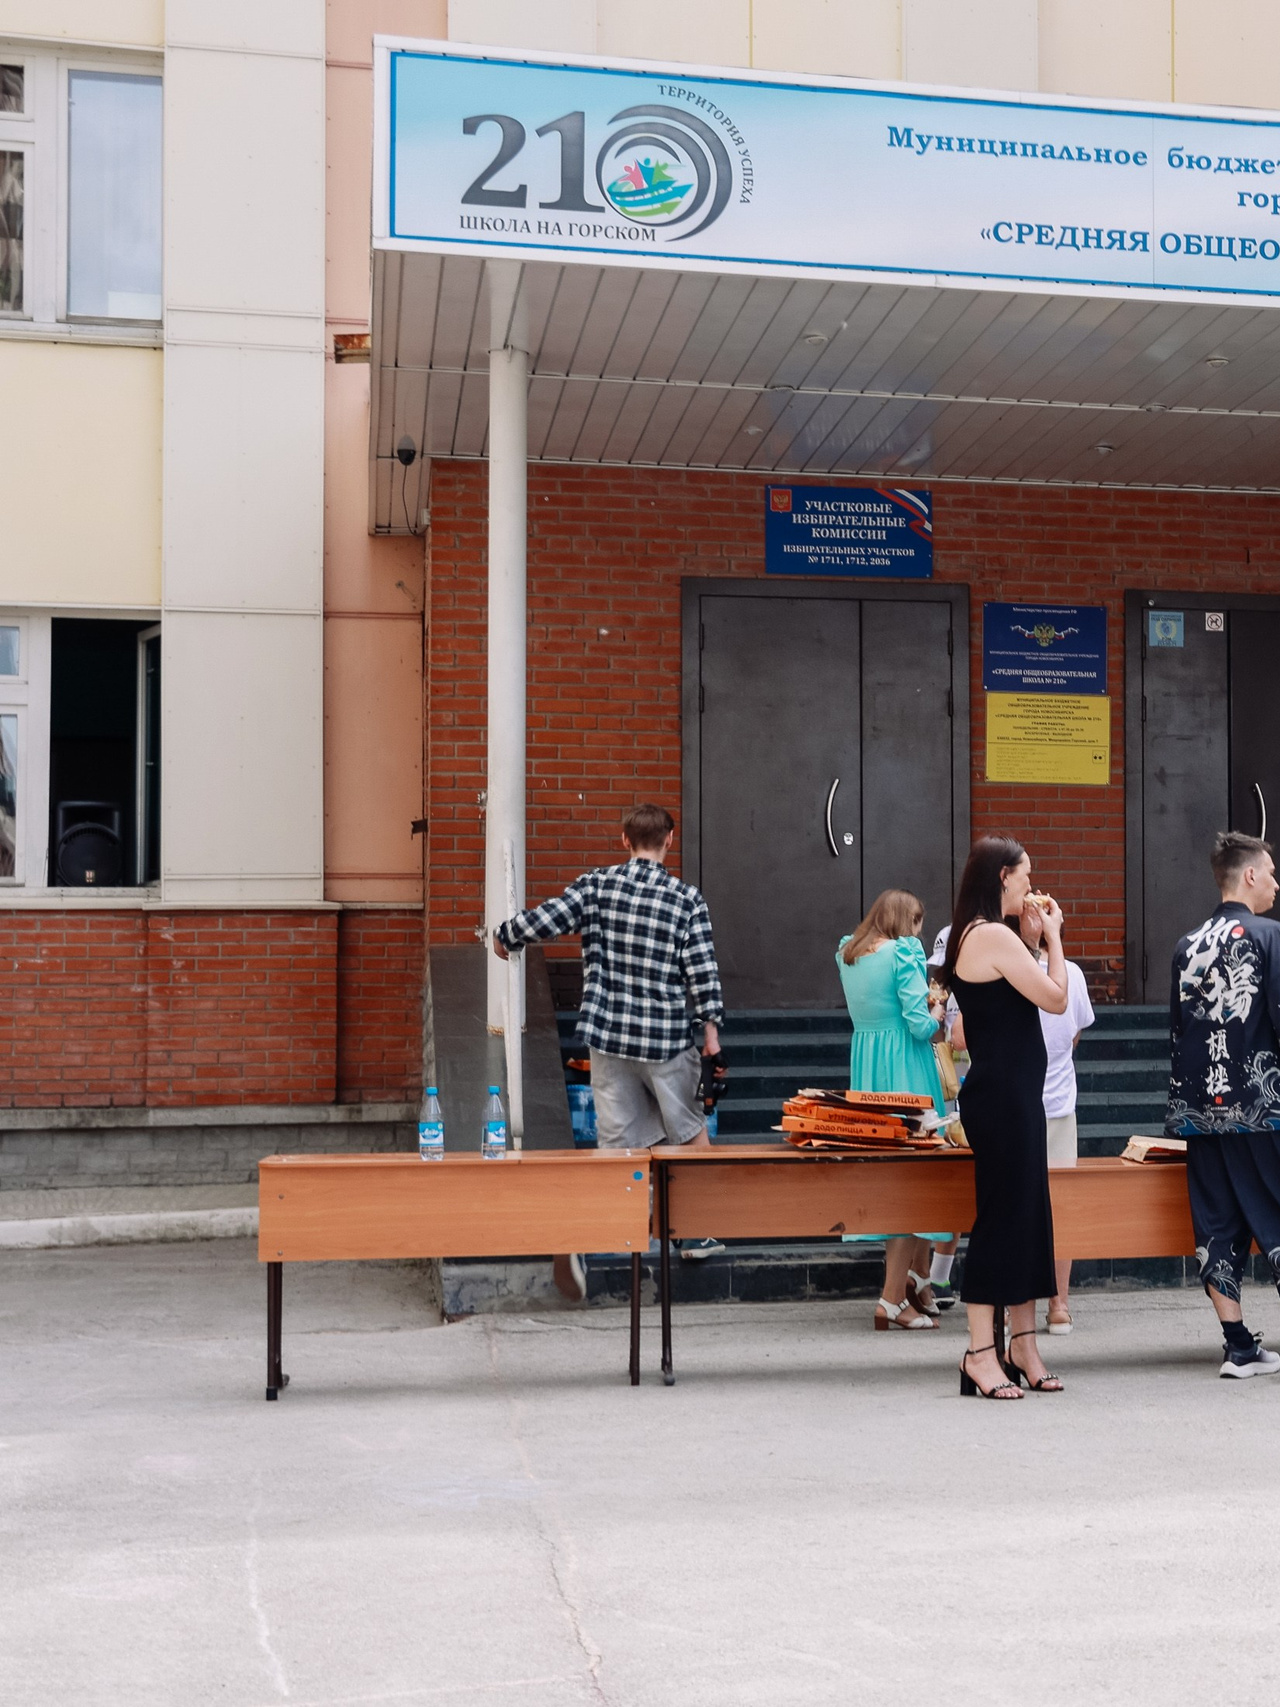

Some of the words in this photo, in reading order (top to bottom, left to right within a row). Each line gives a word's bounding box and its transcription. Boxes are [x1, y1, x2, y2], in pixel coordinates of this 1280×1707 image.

[657, 84, 745, 146] ТЕРРИТОРИЯ
[738, 149, 755, 205] УСПЕХА
[886, 126, 1148, 167] Муниципальное
[459, 215, 531, 235] ШКОЛА
[537, 220, 564, 236] НА
[568, 222, 657, 242] ГОРСКОМ
[980, 220, 1150, 253] «СРЕДНЯЯ
[805, 500, 893, 514] УЧАСТКОВЫЕ
[792, 513, 906, 528] ИЗБИРАТЕЛЬНЫЕ
[811, 527, 887, 540] КОМИССИИ
[783, 544, 865, 555] ИЗБИРАТЕЛЬНЫХ
[867, 547, 915, 556] УЧАСТКОВ
[821, 556, 843, 565] 1711,
[846, 557, 868, 566] 1712,
[860, 1093, 887, 1103] ДОДО
[888, 1095, 920, 1105] ПИЦЦА
[814, 1124, 836, 1132] ДОДО
[836, 1126, 864, 1135] ПИЦЦА
